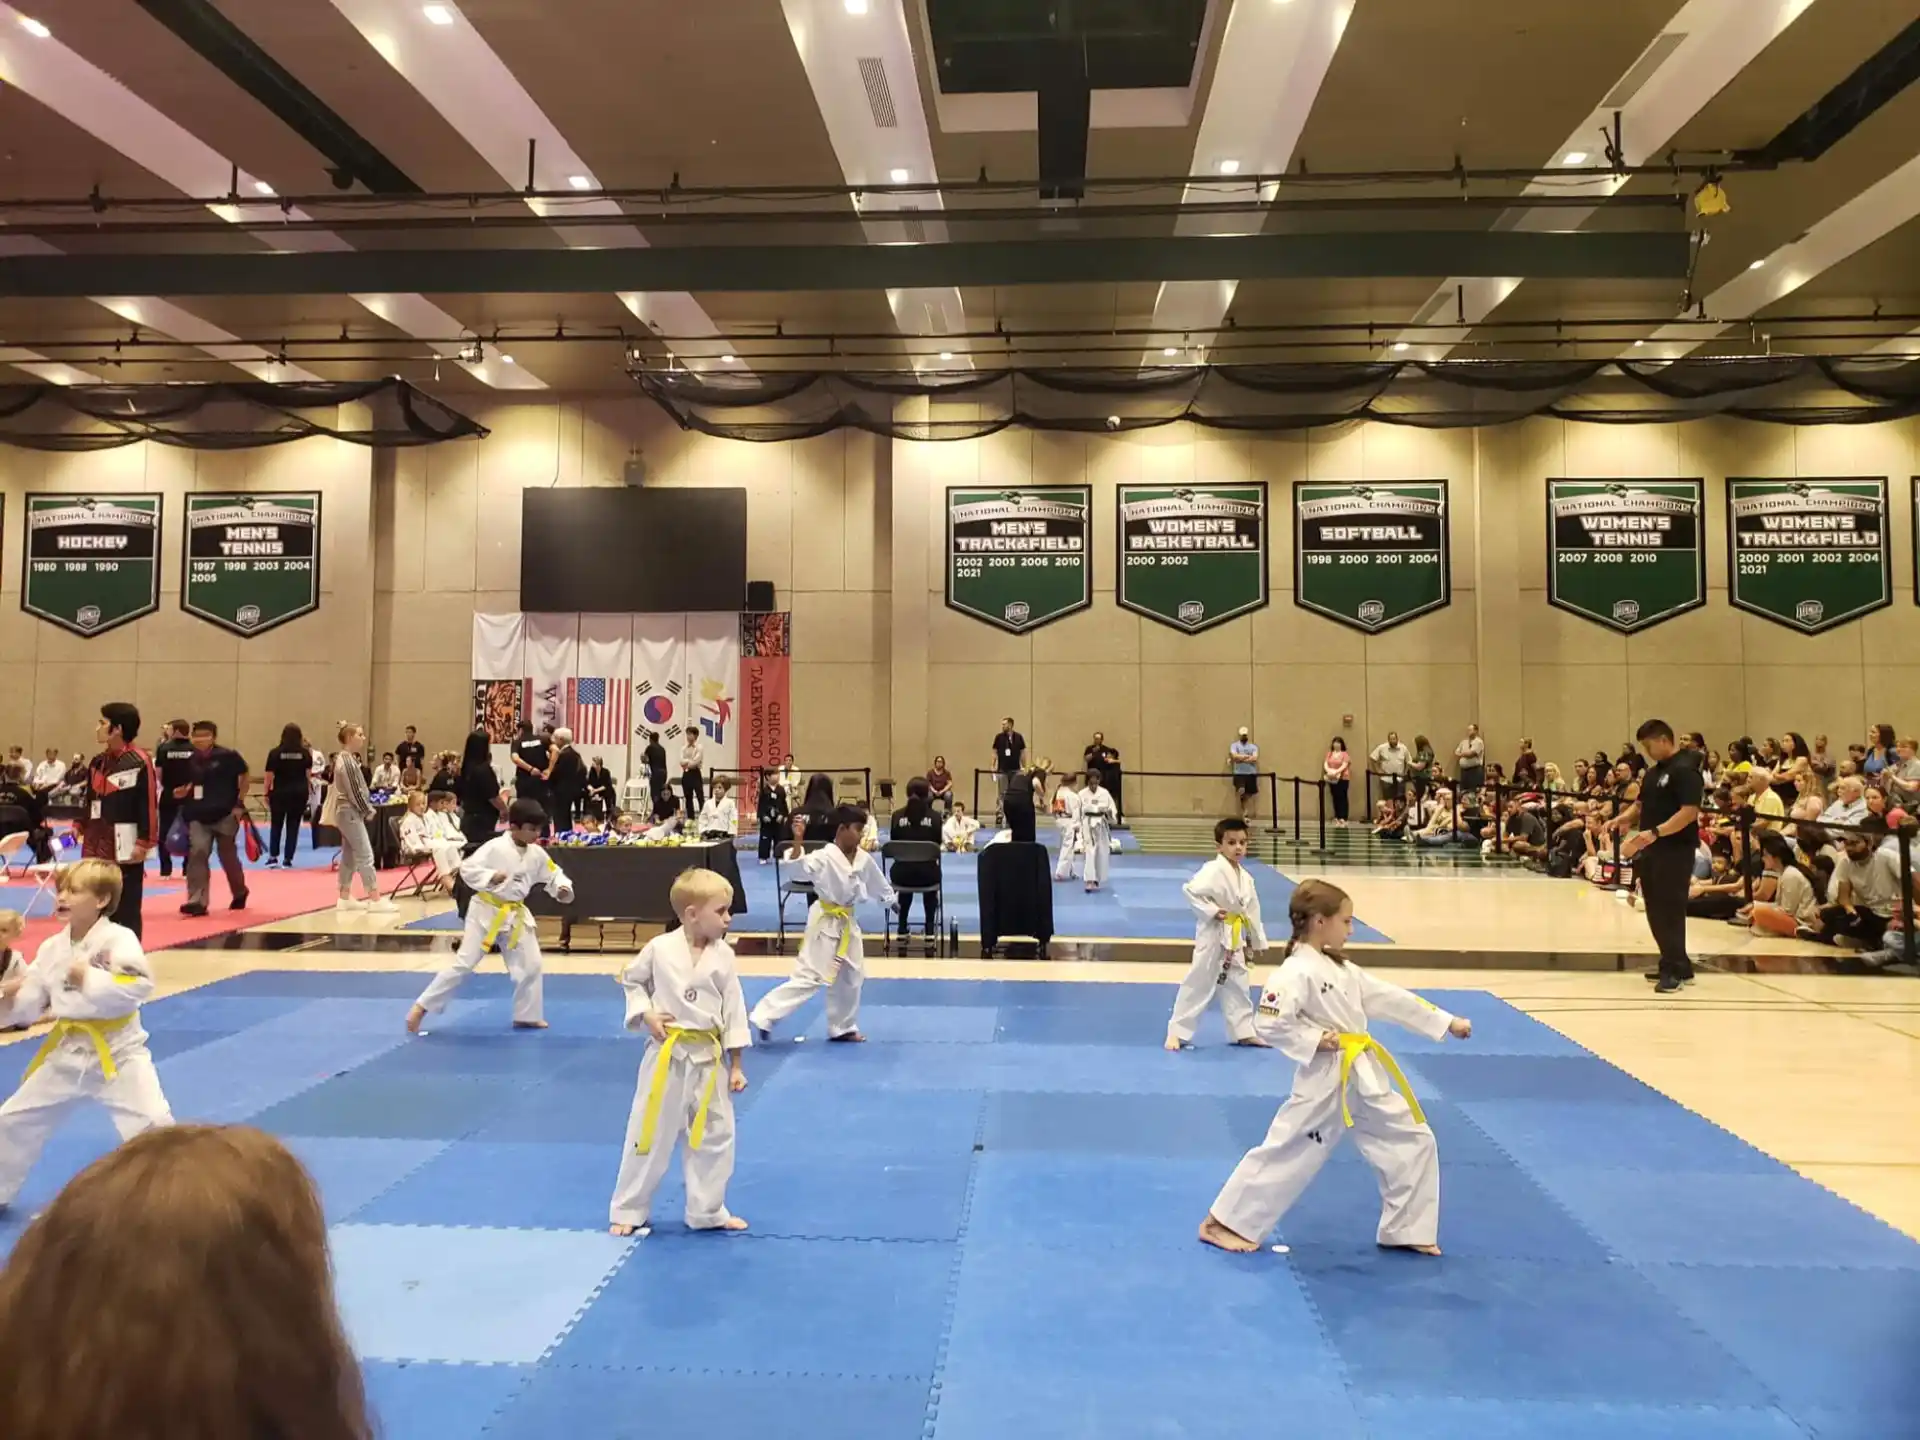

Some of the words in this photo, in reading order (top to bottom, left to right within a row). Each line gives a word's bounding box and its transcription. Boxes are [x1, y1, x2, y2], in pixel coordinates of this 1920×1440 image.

[1131, 504, 1184, 516] NATIONAL
[1309, 502, 1364, 514] NATIONAL
[1561, 500, 1617, 511] NATIONAL
[1742, 500, 1799, 512] NATIONAL
[1805, 499, 1876, 512] CHAMPIONS
[38, 512, 86, 523] NATIONAL
[196, 511, 245, 523] NATIONAL
[960, 507, 1012, 518] NATIONAL
[1017, 506, 1080, 518] CHAMPIONS
[990, 521, 1047, 535] MEN'S
[1147, 519, 1236, 534] WOMEN'S
[1580, 515, 1671, 530] WOMEN'S
[1760, 515, 1856, 530] WOMEN'S
[225, 526, 278, 540] MEN'S
[1319, 526, 1423, 540] SOFTBALL
[1589, 532, 1662, 546] TENNIS
[1738, 531, 1878, 546] TRACK&FIELD
[57, 535, 128, 550] HOCKEY
[955, 537, 1082, 551] TRACK&FIELD
[1129, 534, 1256, 549] BASKETBALL
[219, 541, 284, 555] TENNIS
[956, 558, 983, 567] 2002
[988, 557, 1016, 567] 2003
[1055, 557, 1080, 567] 2010
[1126, 556, 1155, 566] 2000
[1161, 556, 1189, 566] 2002
[1307, 555, 1332, 564] 1998
[1339, 555, 1369, 564] 2000
[1376, 555, 1402, 564] 2001
[1409, 554, 1438, 564] 2004
[1559, 553, 1588, 563] 2007
[1594, 553, 1623, 563] 2008
[1630, 553, 1657, 563] 2010
[1739, 553, 1770, 563] 2000
[1776, 553, 1805, 563] 2001
[1812, 553, 1842, 563] 2002
[1849, 553, 1880, 563] 2004
[33, 562, 57, 572] 1980
[95, 562, 119, 572] 1990
[193, 562, 216, 571] 1997
[224, 562, 247, 571] 1998
[253, 562, 279, 571] 2003
[284, 561, 310, 570] 2004
[1740, 565, 1767, 575] 2021
[191, 573, 218, 583] 2005
[957, 568, 981, 578] 2021
[751, 666, 763, 758] TAEKWONDO
[767, 702, 781, 766] CHICAGO
